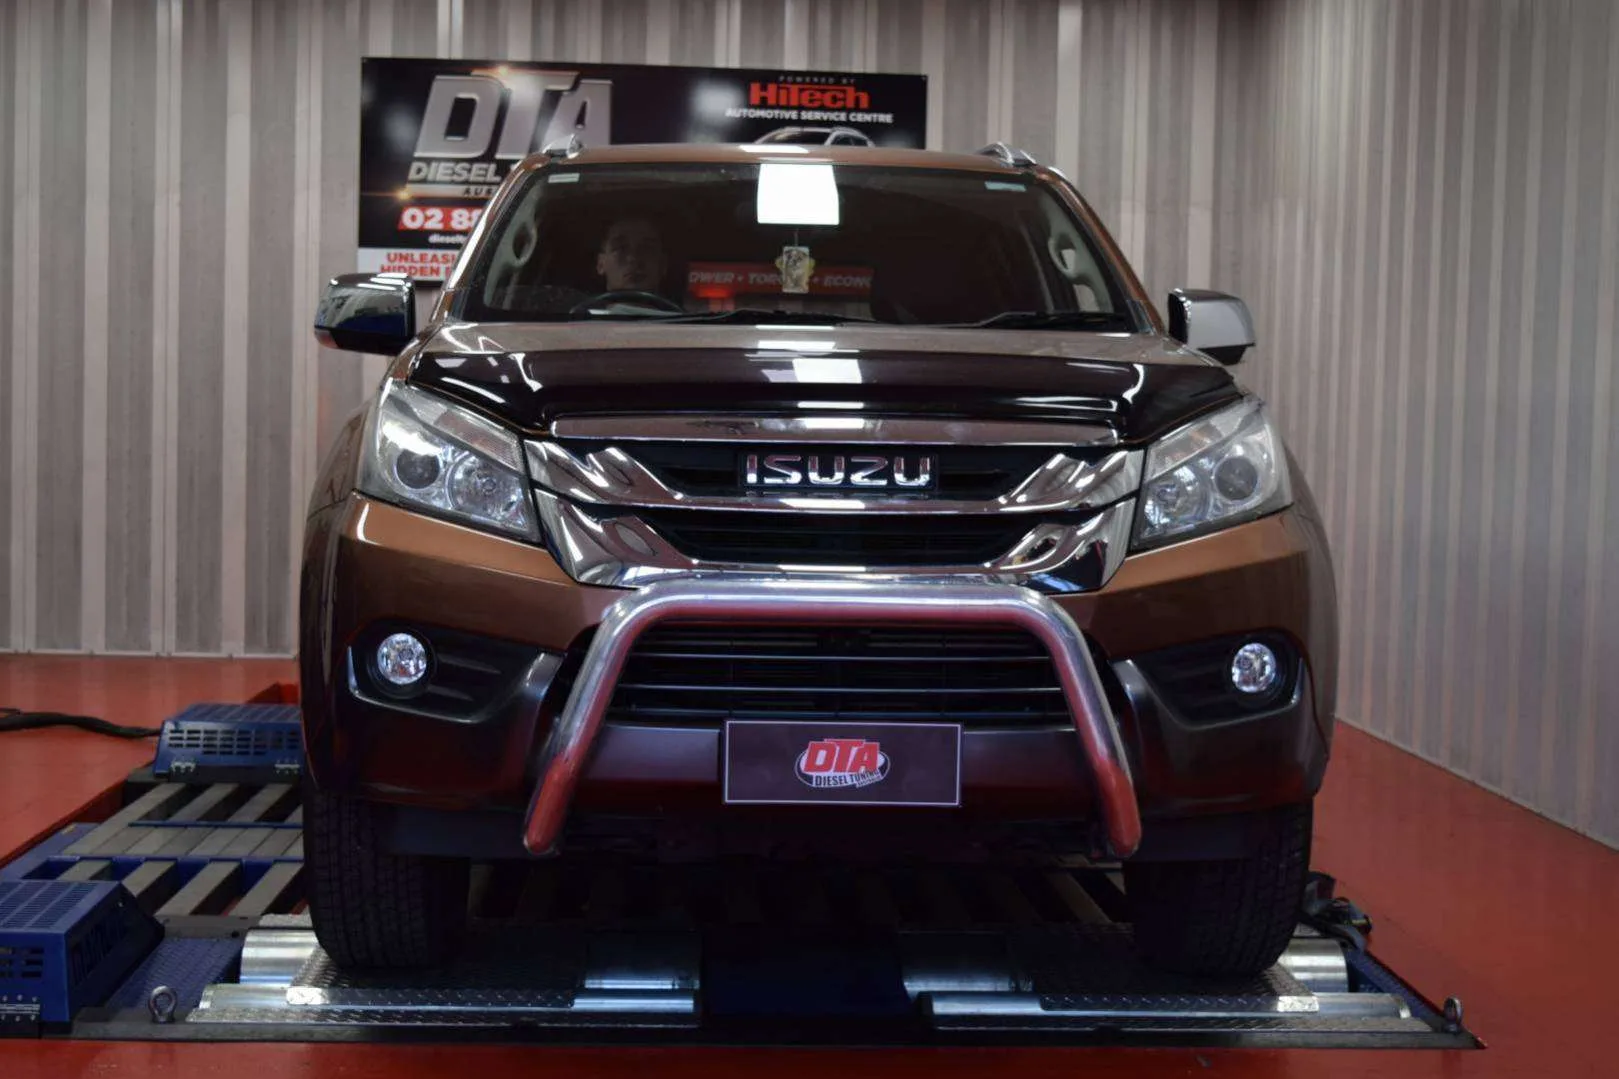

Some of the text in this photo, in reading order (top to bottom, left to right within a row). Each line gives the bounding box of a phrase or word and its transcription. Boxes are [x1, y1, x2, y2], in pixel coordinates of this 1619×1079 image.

[779, 75, 834, 84] POWERED
[749, 82, 870, 109] HiTech
[413, 69, 613, 159] DTA
[725, 107, 893, 124] AUTOMOTIVE SERVICE CENTRE
[407, 161, 502, 182] DIESEL
[401, 206, 444, 229] 02
[381, 264, 440, 277] HIDDEN
[746, 454, 931, 487] ISUZU
[803, 738, 880, 774] DTA
[814, 774, 849, 787] DIESEL
